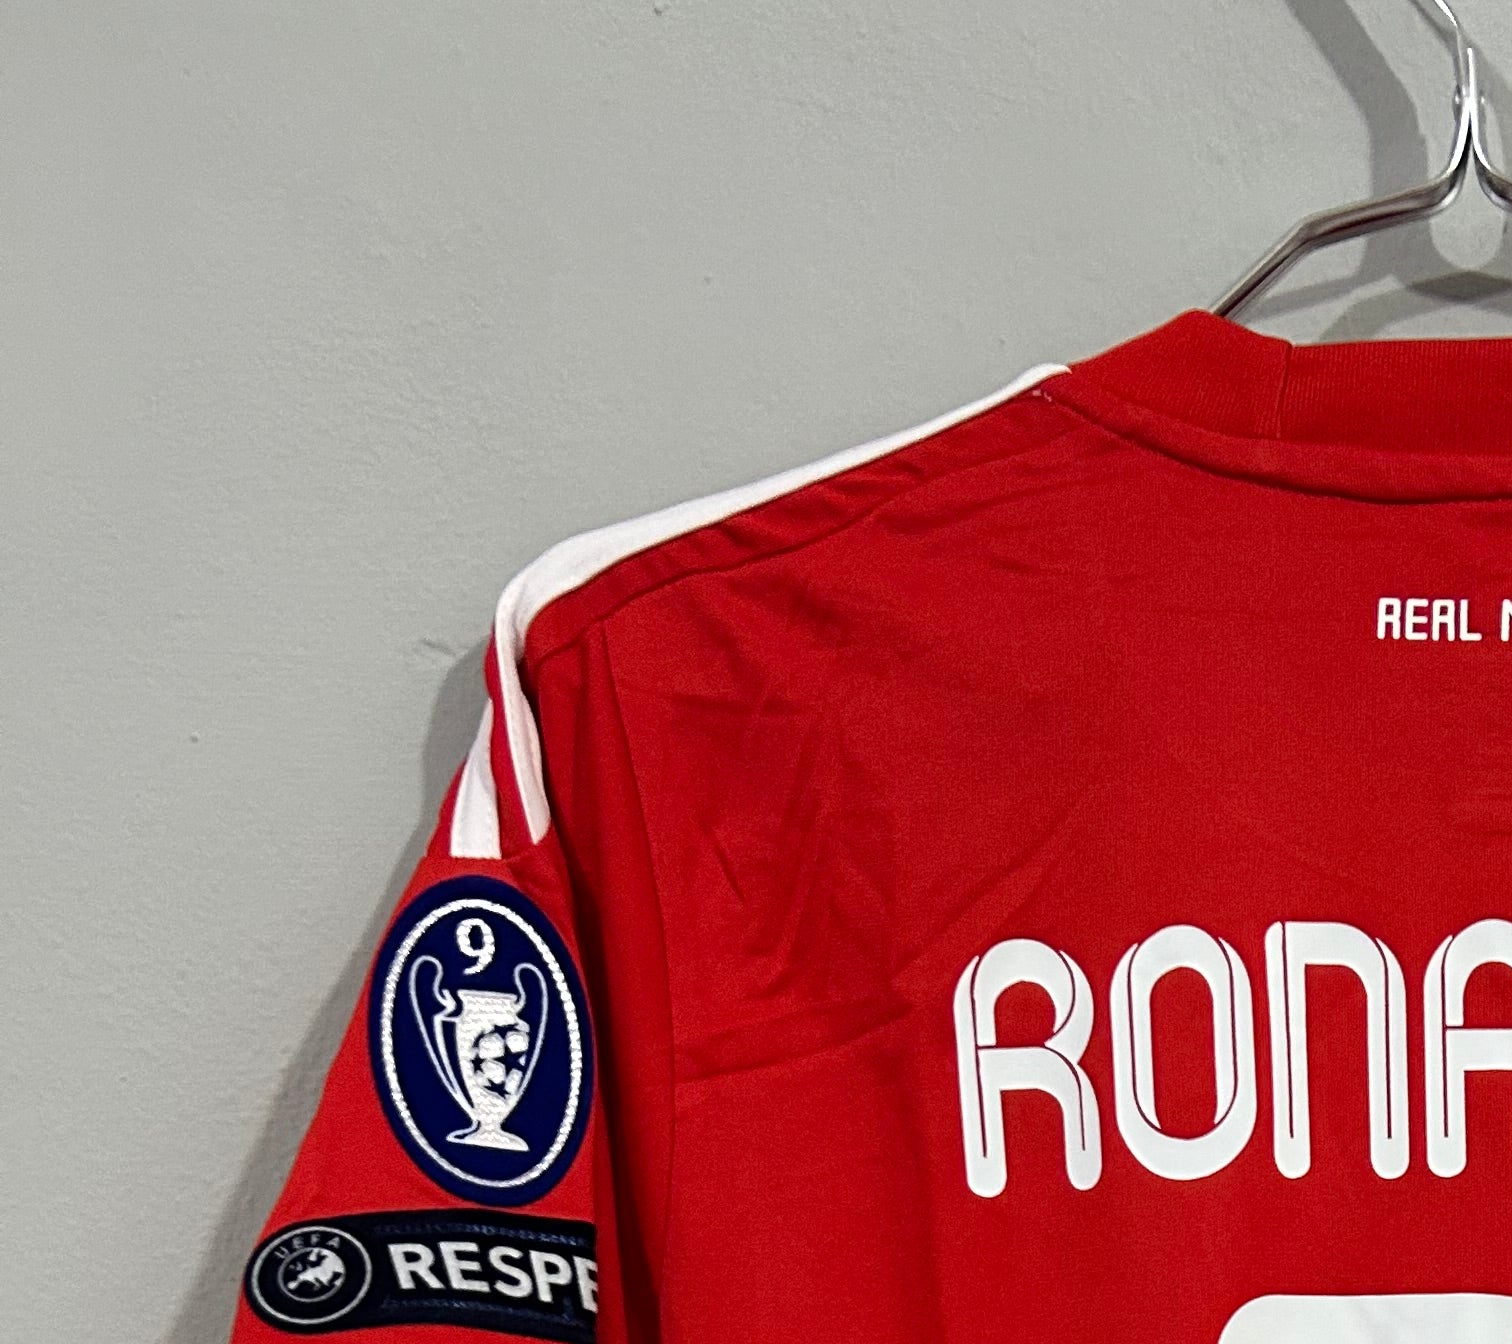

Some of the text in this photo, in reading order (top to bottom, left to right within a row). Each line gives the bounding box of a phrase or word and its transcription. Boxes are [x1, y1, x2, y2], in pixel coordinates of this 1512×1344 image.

[1376, 597, 1483, 642] REAL
[455, 917, 496, 975] 9
[273, 1232, 341, 1260] UEFA
